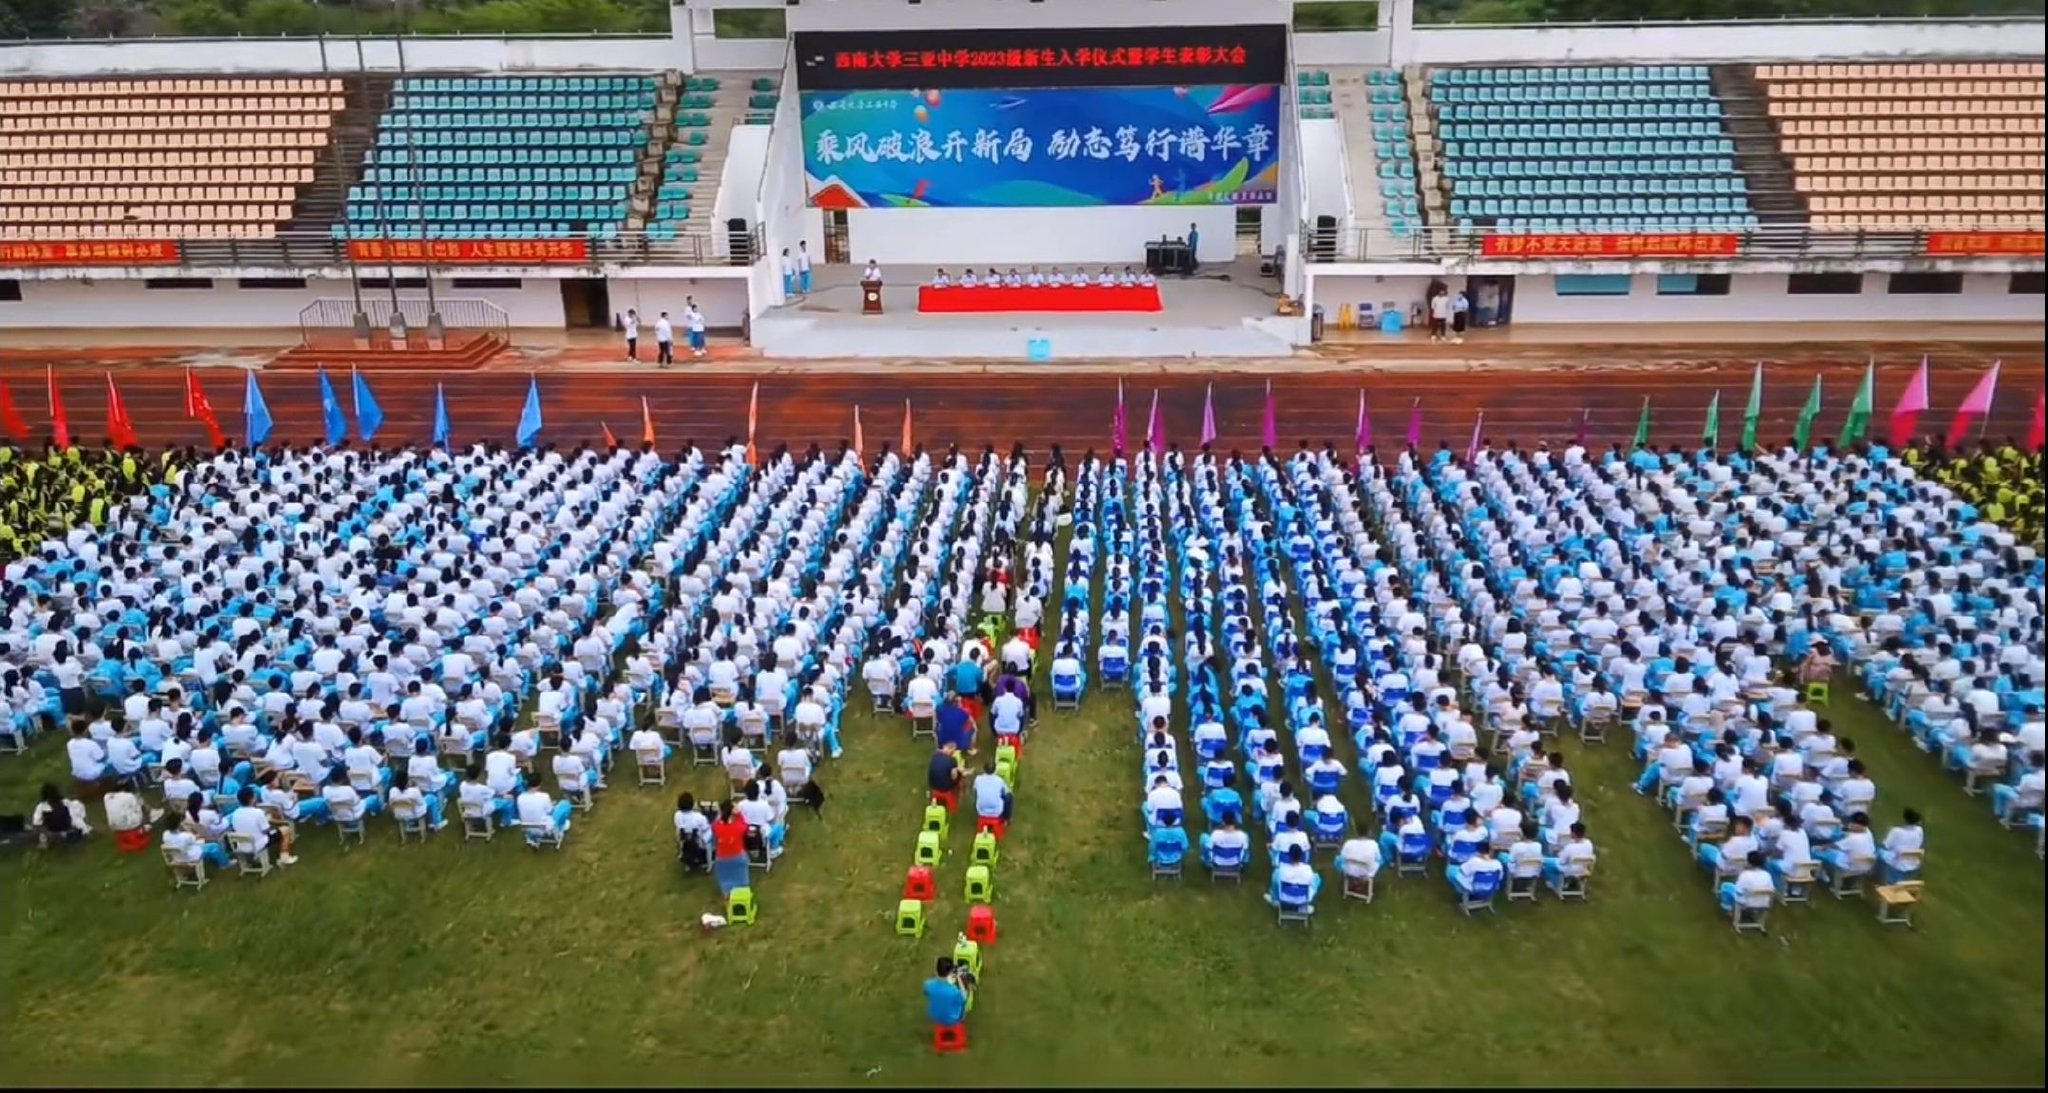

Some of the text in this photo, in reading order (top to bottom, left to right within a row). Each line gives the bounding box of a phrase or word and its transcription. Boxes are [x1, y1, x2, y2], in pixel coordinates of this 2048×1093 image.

[836, 46, 1246, 69] 西南大学三亚中学2023级新生入学仪式暨学生表彰大会
[816, 125, 1272, 163] 乘风破浪开新局 励志笃行谱华章
